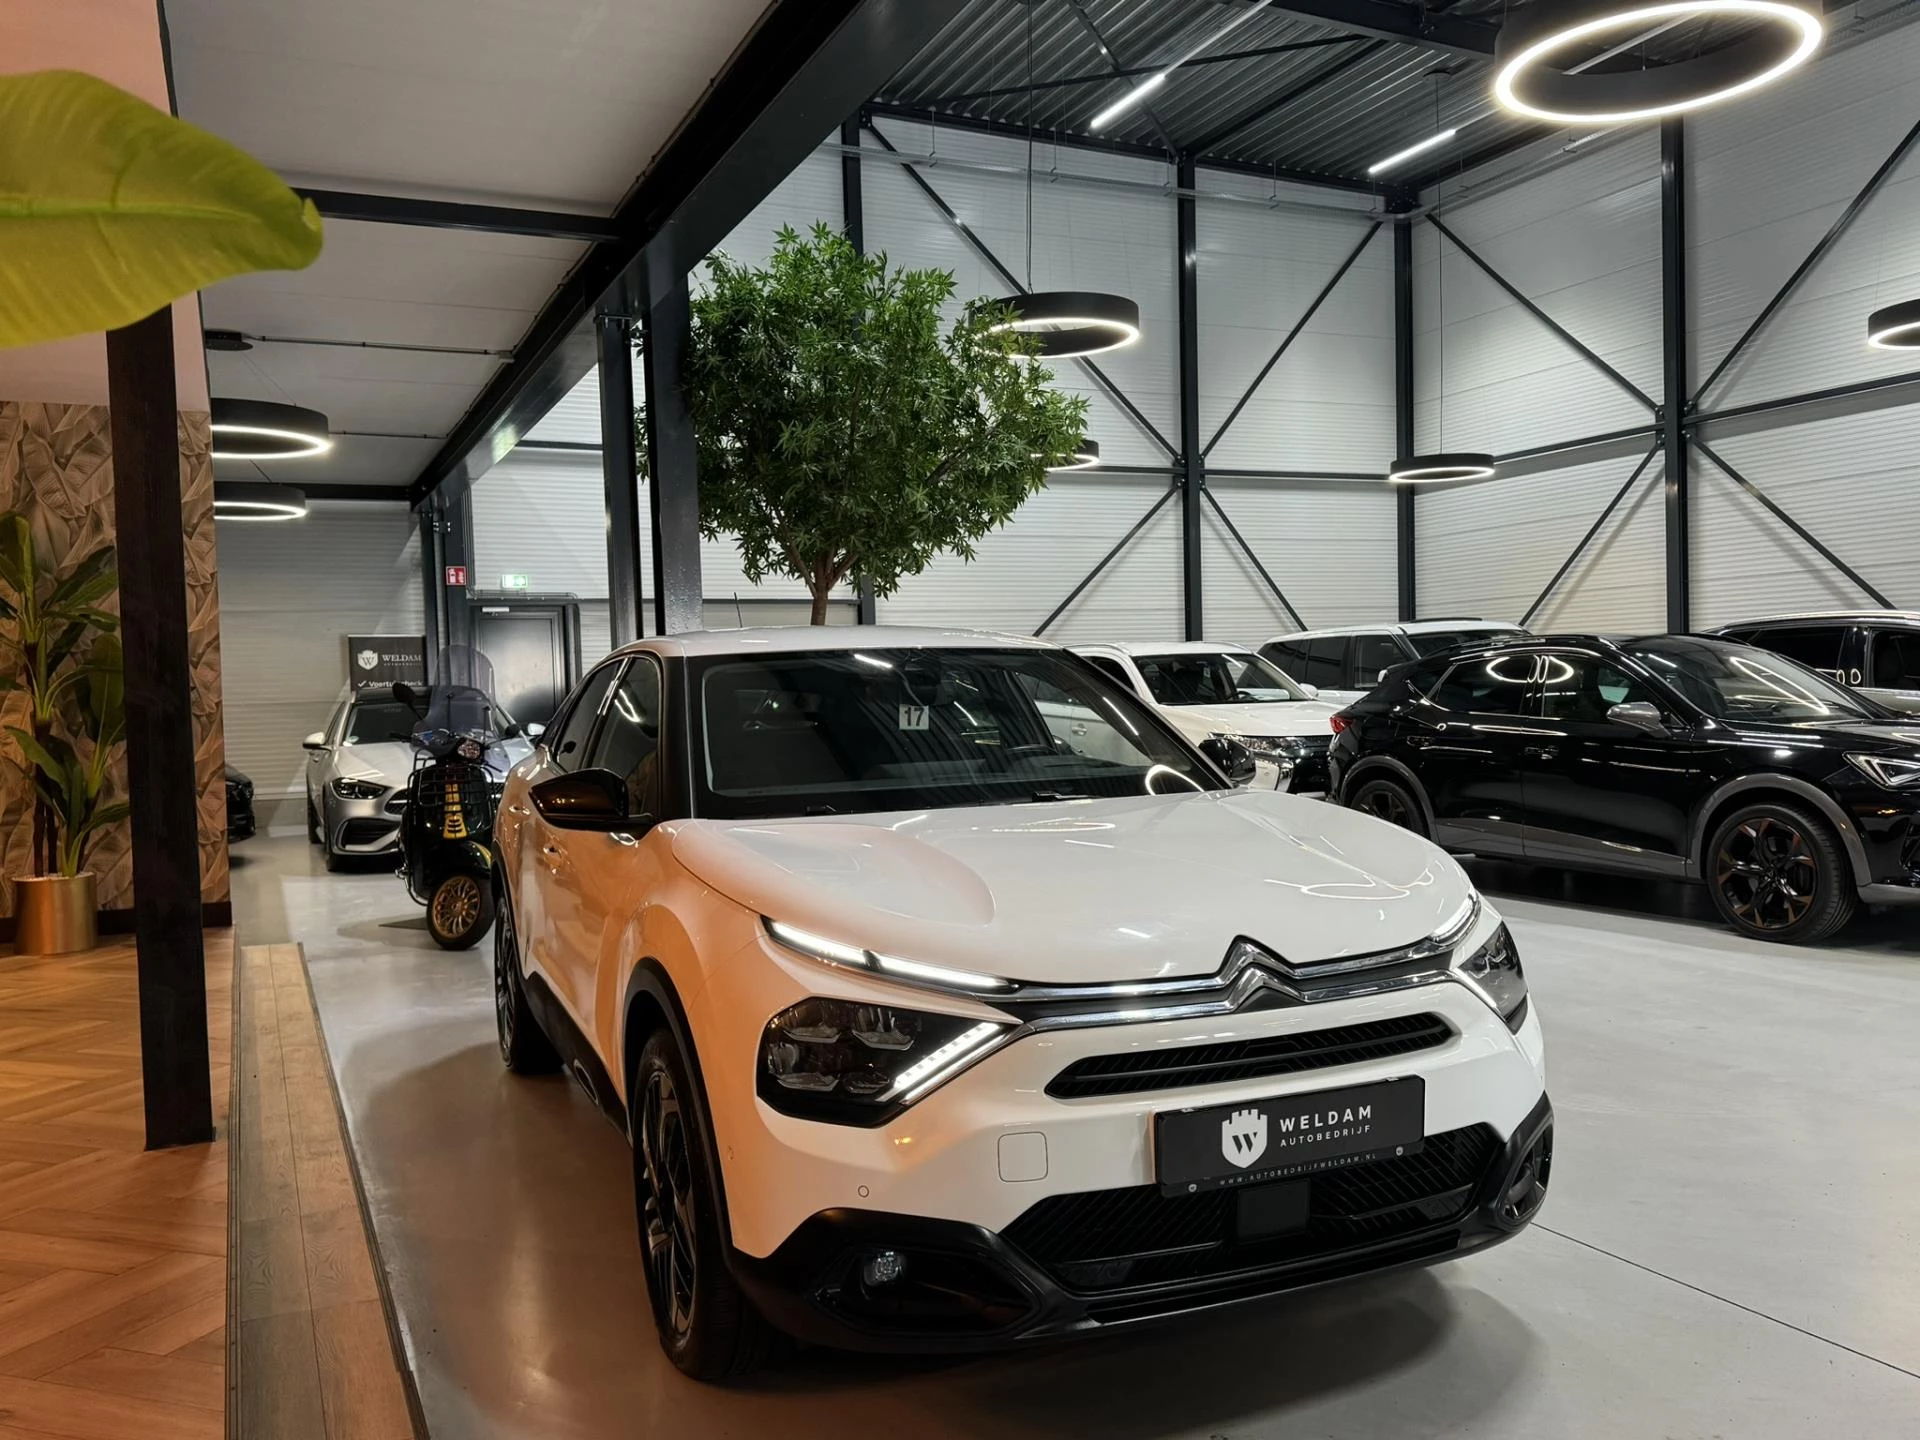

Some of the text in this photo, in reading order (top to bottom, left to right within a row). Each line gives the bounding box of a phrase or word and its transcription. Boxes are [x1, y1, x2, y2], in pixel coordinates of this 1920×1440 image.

[382, 654, 421, 662] WELDAM
[904, 707, 925, 727] 17
[1279, 1104, 1372, 1133] WELDAM
[1231, 1131, 1259, 1154] W
[1280, 1124, 1371, 1147] AUTOBEDRIJF
